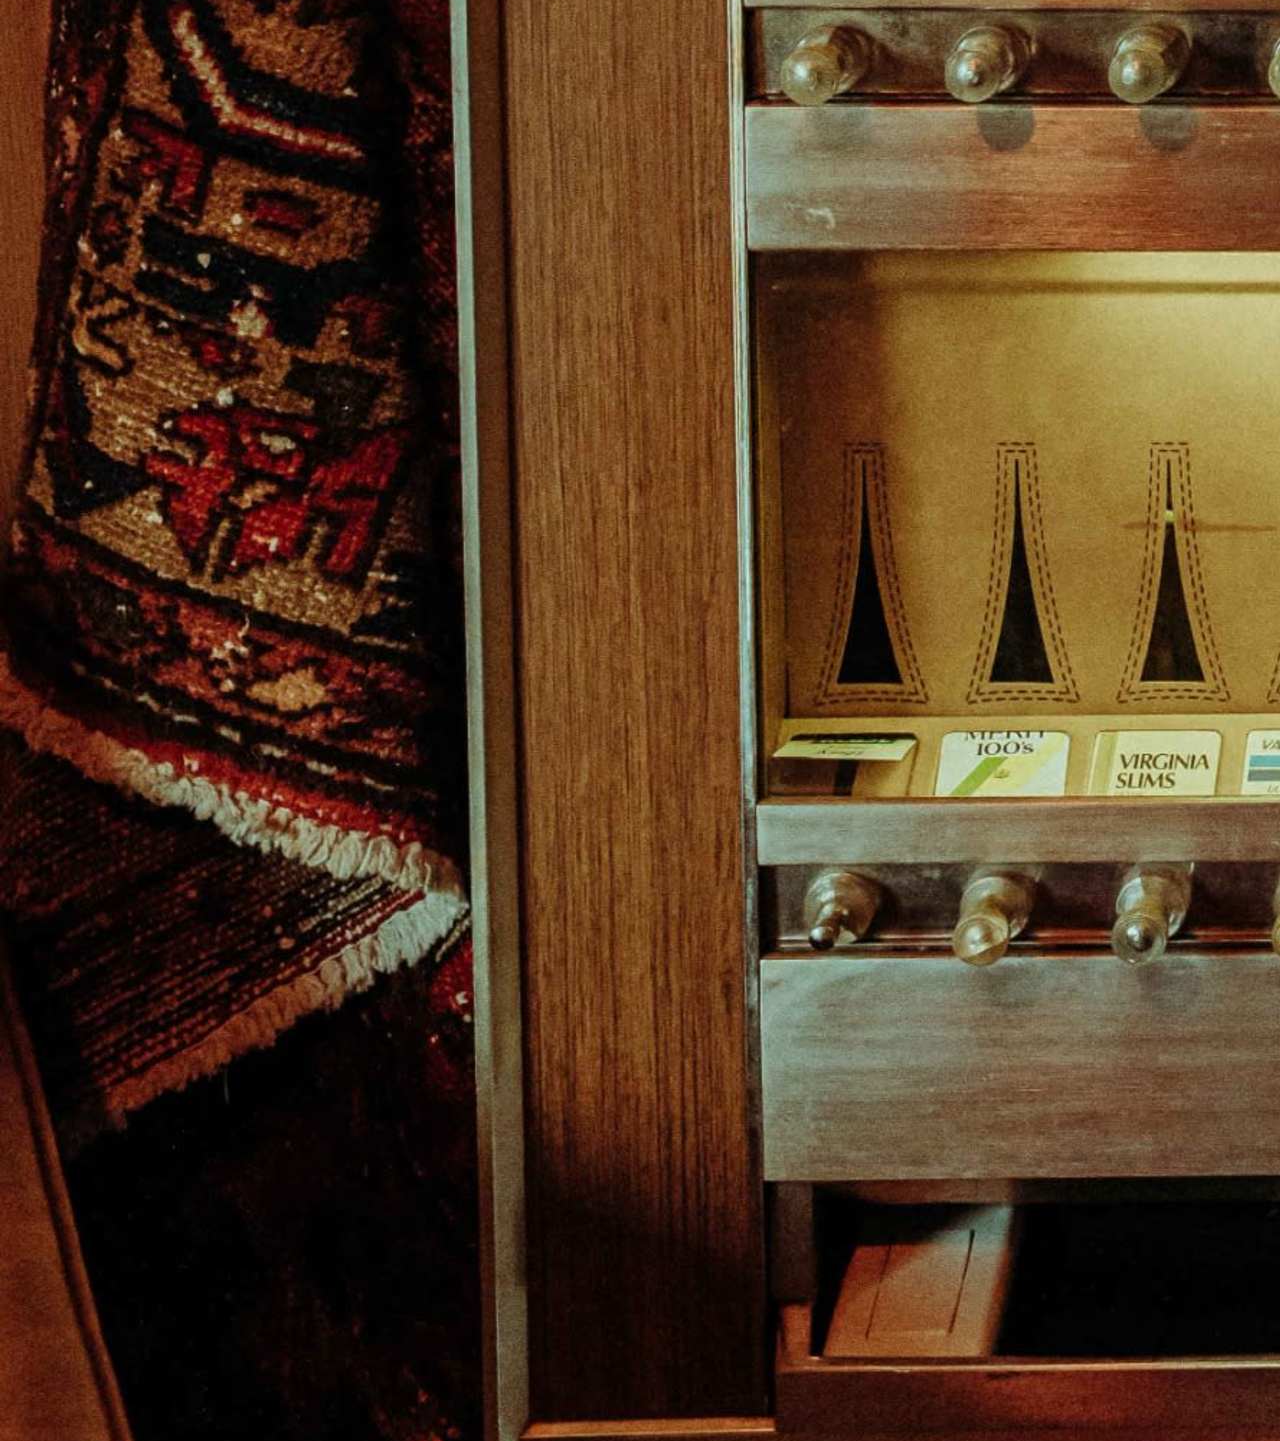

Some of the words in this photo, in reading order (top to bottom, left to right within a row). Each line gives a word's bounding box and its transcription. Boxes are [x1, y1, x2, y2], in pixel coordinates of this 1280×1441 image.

[976, 742, 1035, 757] 100's
[1119, 752, 1210, 770] VIRGINIA
[1114, 772, 1176, 790] SLIMS
